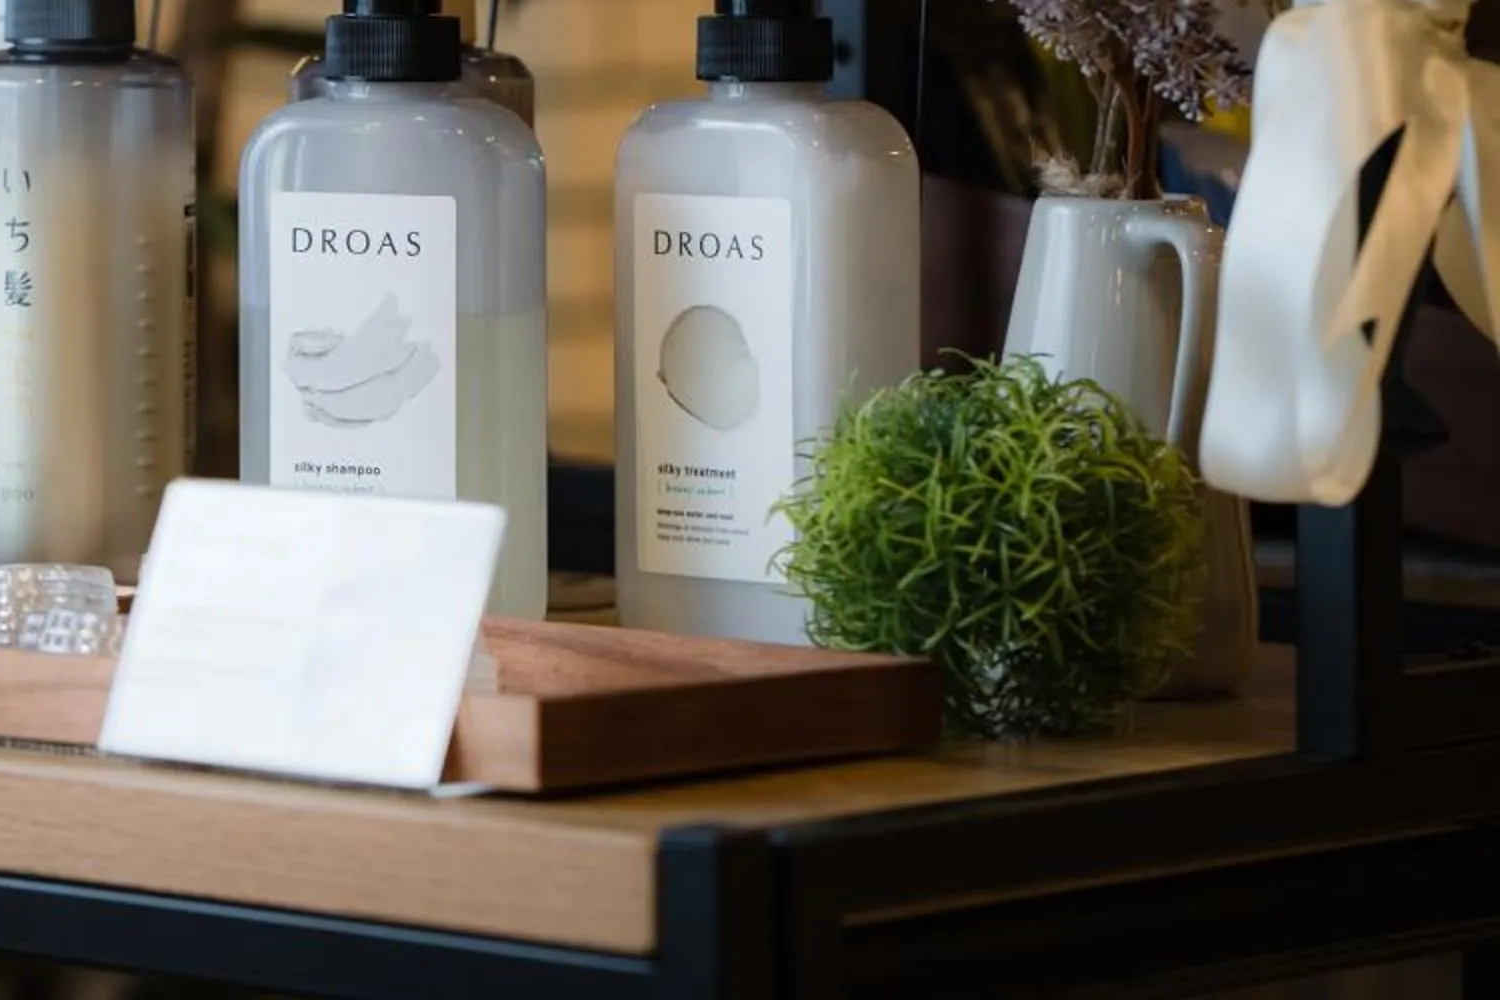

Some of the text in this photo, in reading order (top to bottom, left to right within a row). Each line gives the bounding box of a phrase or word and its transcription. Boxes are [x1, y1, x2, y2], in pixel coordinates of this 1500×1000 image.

[3, 168, 33, 308] いち髪
[291, 227, 422, 257] DROAS
[653, 229, 765, 262] DROAS
[294, 461, 382, 478] silky shampoo
[657, 463, 736, 480] silky treatment
